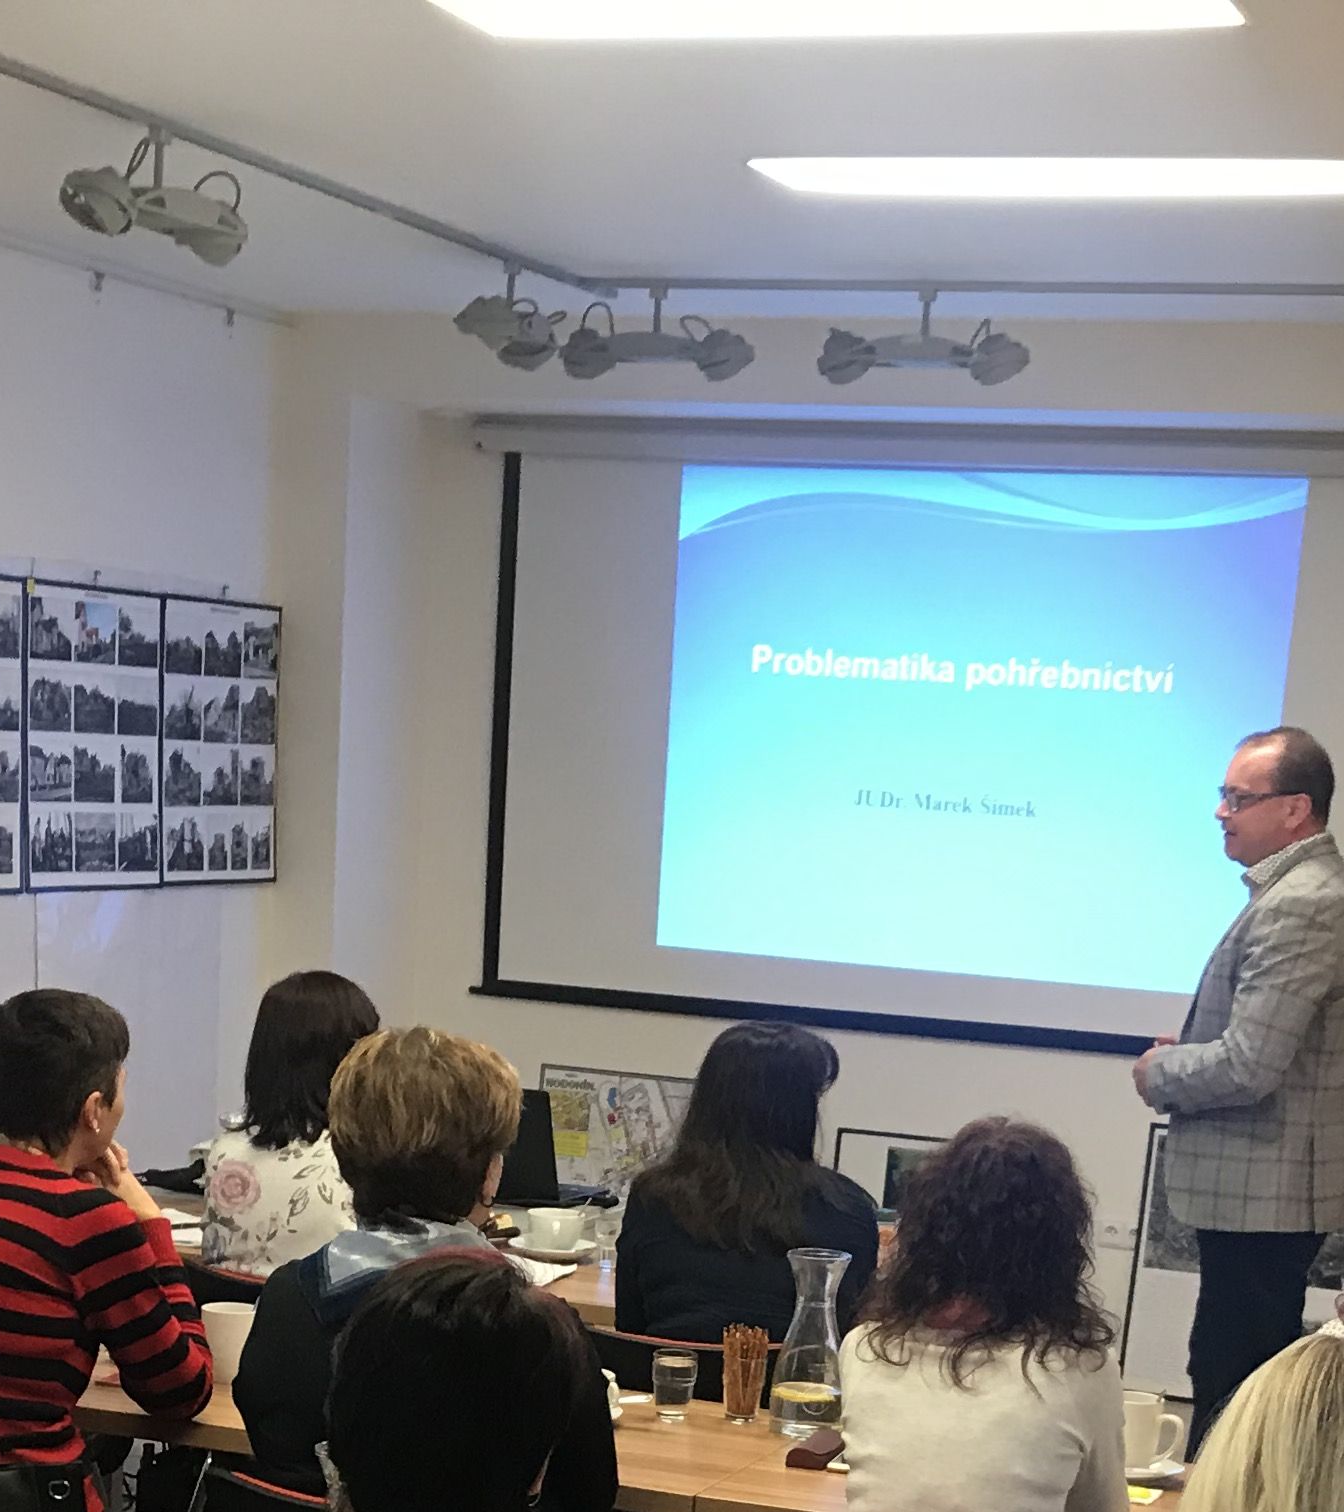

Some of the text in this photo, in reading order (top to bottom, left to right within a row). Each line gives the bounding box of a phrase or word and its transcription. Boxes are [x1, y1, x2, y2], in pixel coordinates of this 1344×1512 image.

[751, 643, 1175, 694] Problematika pohřebnictví
[914, 792, 973, 814] Marek
[979, 793, 1037, 818] Šimek
